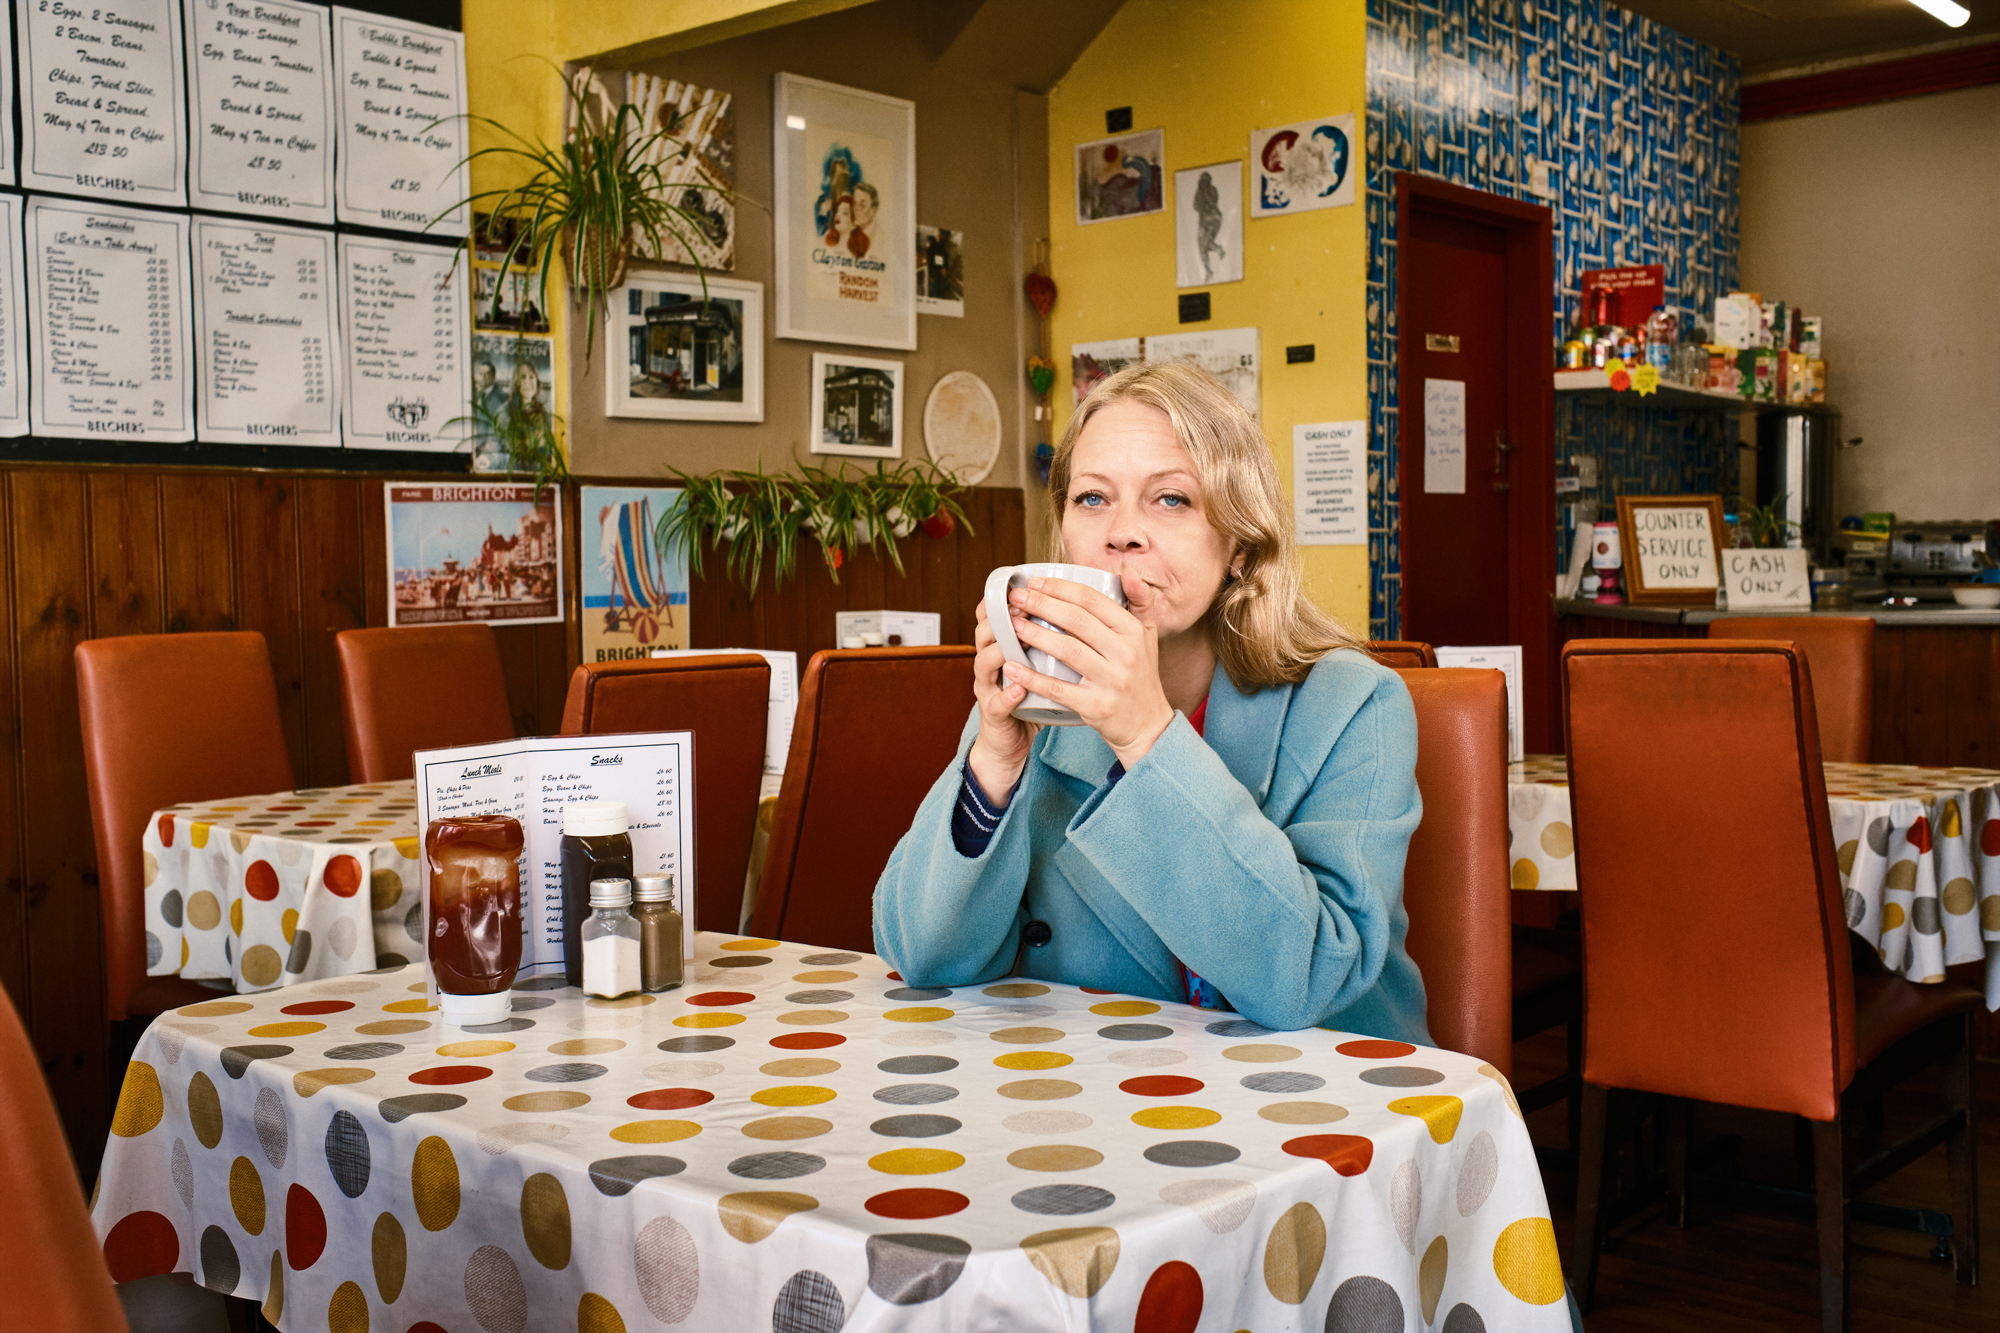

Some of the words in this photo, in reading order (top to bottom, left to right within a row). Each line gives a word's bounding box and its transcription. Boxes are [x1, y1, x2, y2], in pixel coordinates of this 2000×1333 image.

[39, 1, 48, 11] 2
[92, 10, 100, 21] 2
[254, 7, 300, 26] Breakfast
[55, 26, 64, 36] 2
[402, 36, 442, 54] Breakfast
[394, 57, 401, 66] &
[92, 75, 122, 90] Fried
[232, 75, 261, 88] Fried
[56, 92, 90, 108] Bread
[93, 99, 102, 109] &
[221, 99, 251, 114] Bread
[254, 105, 262, 115] &
[364, 100, 391, 114] Bread
[395, 107, 401, 115] &
[43, 113, 72, 131] Mug
[76, 121, 87, 133] of
[91, 120, 110, 134] Tea
[115, 128, 125, 136] or
[130, 127, 165, 143] Coffee
[210, 124, 235, 141] Mug
[239, 130, 249, 143] of
[253, 131, 270, 143] Tea
[287, 135, 317, 152] Coffee
[355, 123, 377, 138] Mug
[381, 130, 389, 141] of
[393, 130, 408, 142] Tea
[425, 135, 452, 150] Coffee
[76, 174, 135, 191] BELCHERS
[238, 192, 290, 207] BELCHERS
[381, 209, 428, 224] BELCHERS
[86, 217, 135, 233] Sandwiches
[105, 237, 125, 249] Take
[257, 314, 302, 326] Sandwiches
[88, 421, 145, 433] BELCHERS
[247, 424, 298, 436] BELCHERS
[386, 431, 431, 443] BELCHERS
[1305, 431, 1328, 440] CASH
[1330, 430, 1351, 438] ONLY
[433, 488, 516, 502] BRIGHTON
[1635, 512, 1705, 530] COUNTER
[1638, 538, 1707, 557] SERVICE
[1659, 564, 1699, 579] ONLY
[1731, 556, 1786, 574] CASH
[1741, 577, 1783, 594] ONLY
[591, 753, 623, 766] Snacks
[461, 766, 481, 778] Lunch
[483, 764, 502, 775] Meals
[547, 774, 558, 782] Egg
[446, 785, 457, 793] Chips
